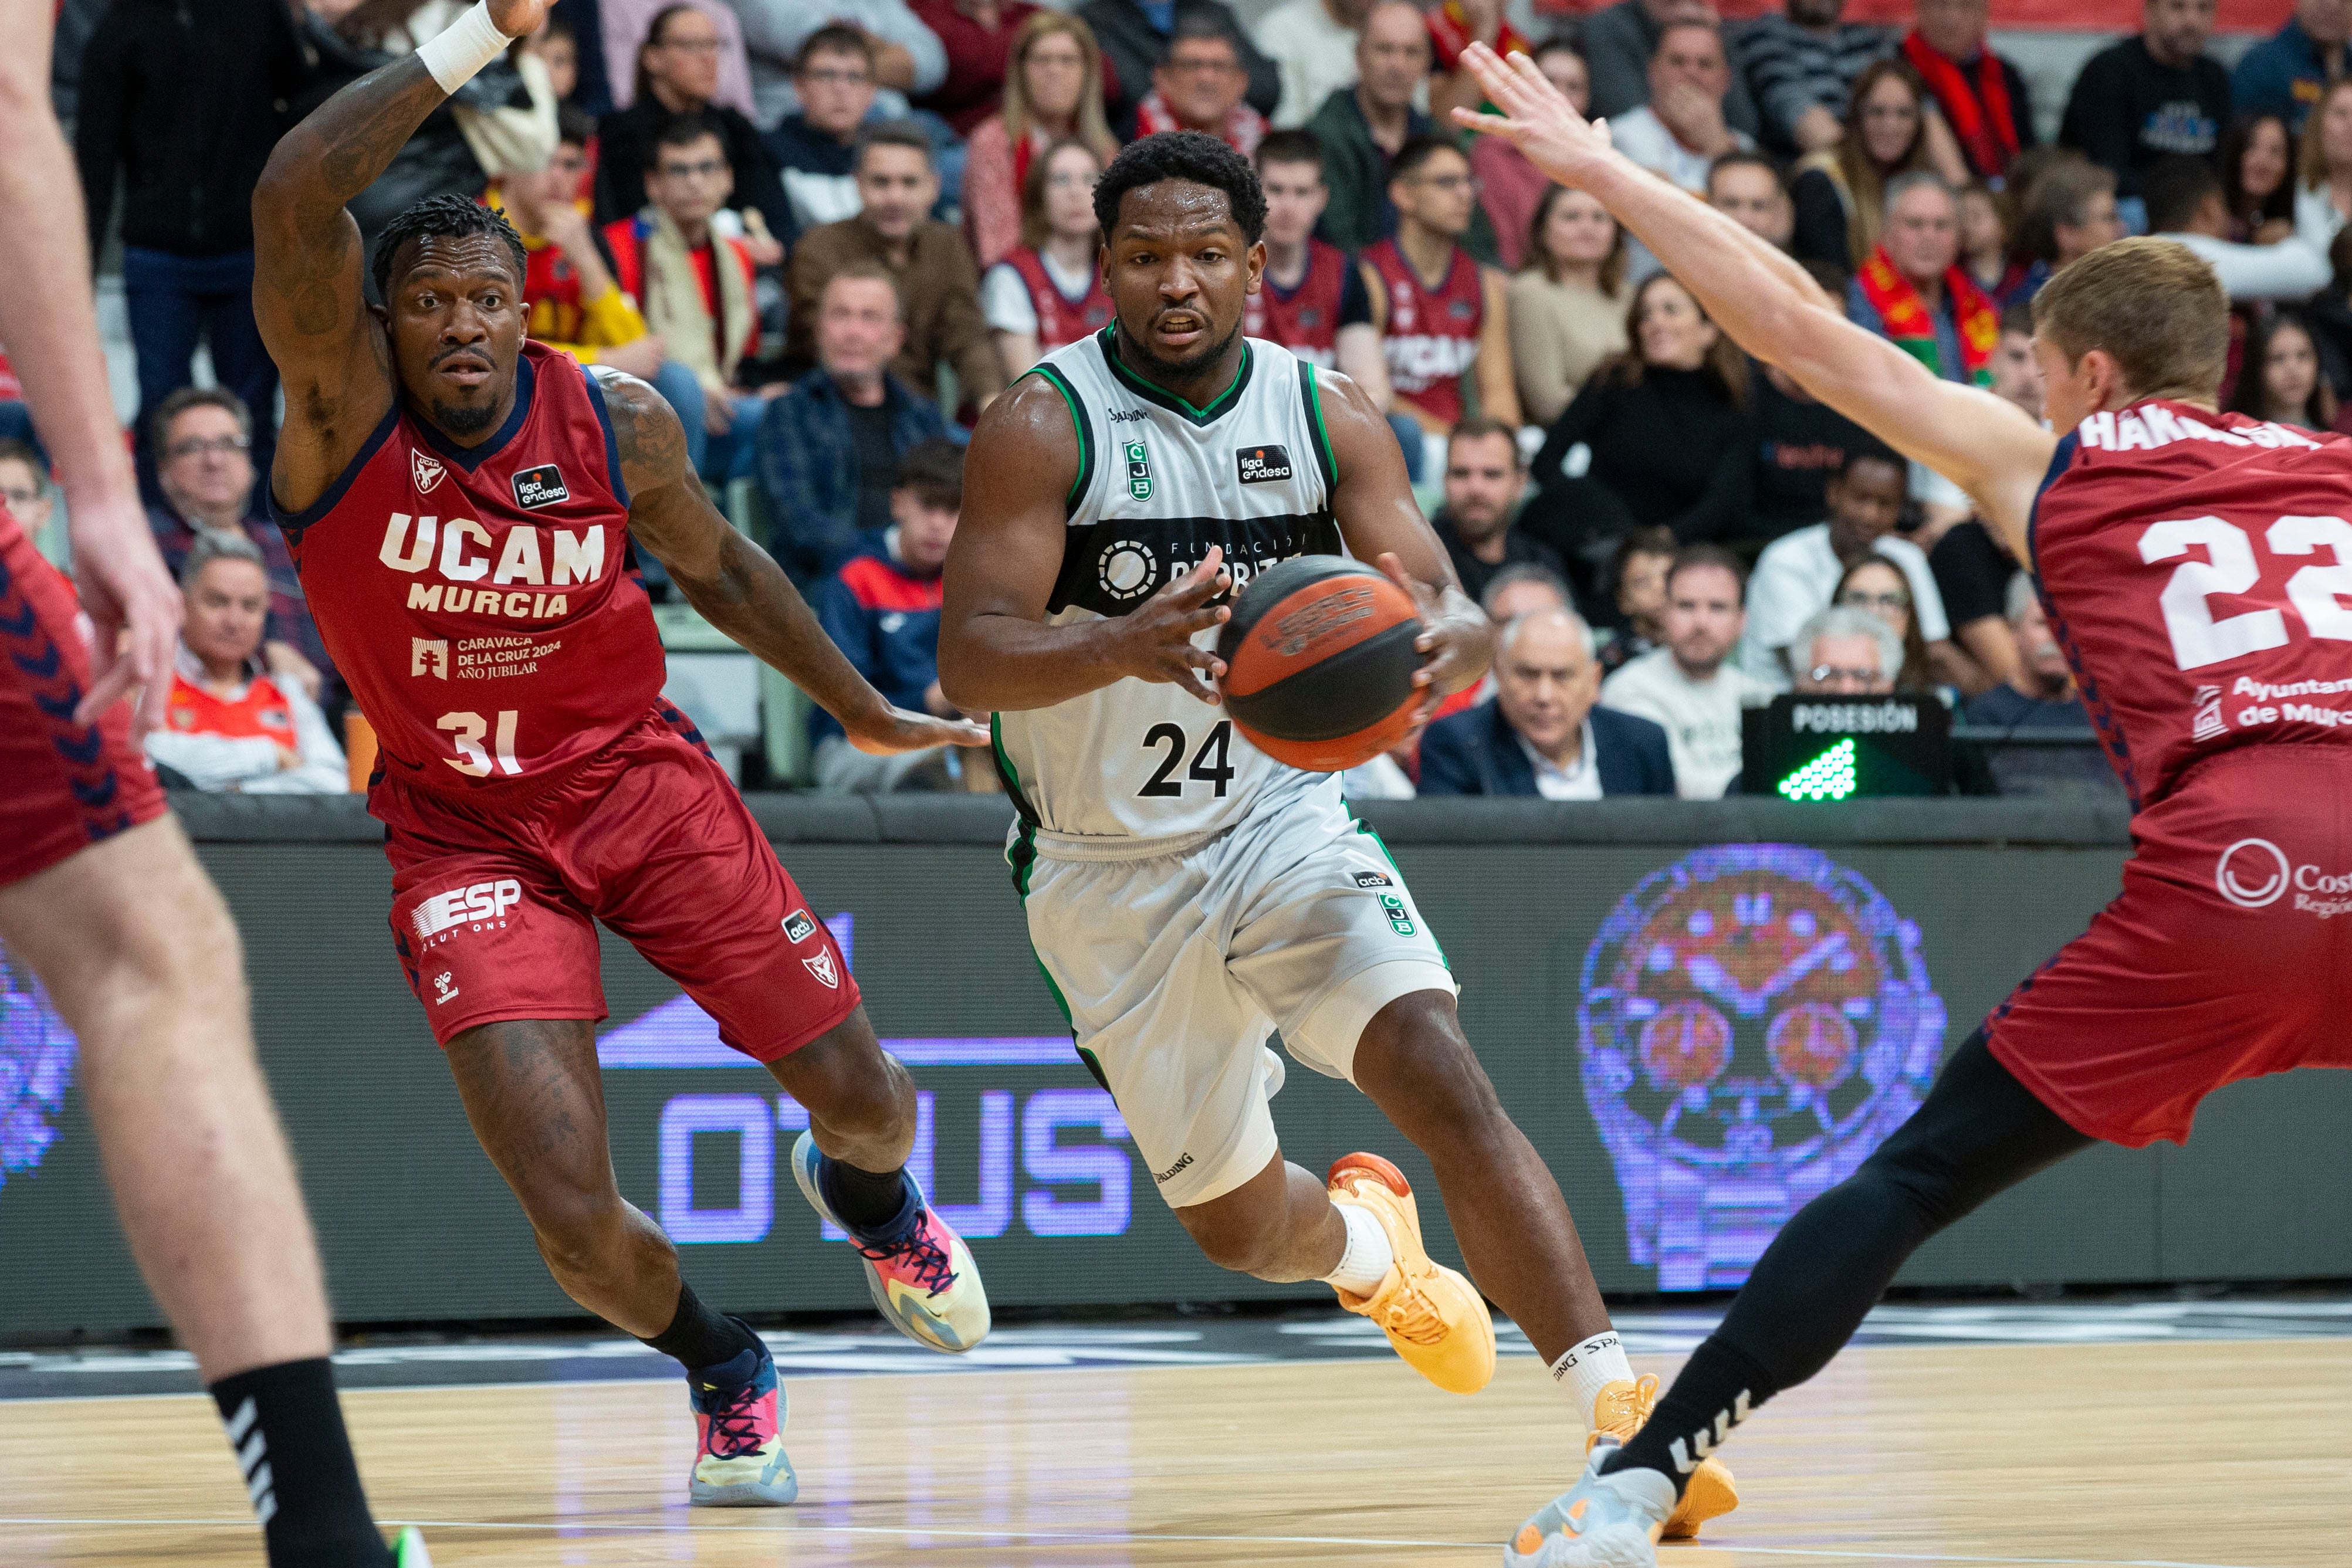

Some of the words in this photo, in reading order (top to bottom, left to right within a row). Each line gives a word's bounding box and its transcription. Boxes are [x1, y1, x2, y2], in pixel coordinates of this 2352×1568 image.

[419, 458, 439, 469] UCAM
[1241, 458, 1263, 470] liga
[1242, 465, 1290, 480] endesa
[519, 482, 542, 495] liga
[522, 486, 566, 504] endesa
[378, 512, 605, 585] UCAM
[407, 583, 568, 619] MURCIA
[2137, 515, 2352, 672] 22
[457, 636, 533, 652] CARAVACA
[458, 654, 475, 666] DE
[477, 653, 493, 665] LA
[495, 649, 530, 663] CRUZ
[532, 641, 561, 658] 2024
[456, 666, 485, 679] AÑO
[486, 661, 538, 680] JUBILAR
[1792, 698, 1918, 733] POSESIÓN
[2238, 705, 2279, 726] de
[436, 710, 523, 778] 31
[1137, 720, 1234, 797] 24
[1358, 876, 1386, 887] acb
[2295, 864, 2352, 894] Cos
[425, 879, 522, 934] ESP
[421, 920, 506, 954] OLUTONS
[790, 921, 810, 939] acb
[435, 987, 459, 1006] hummel
